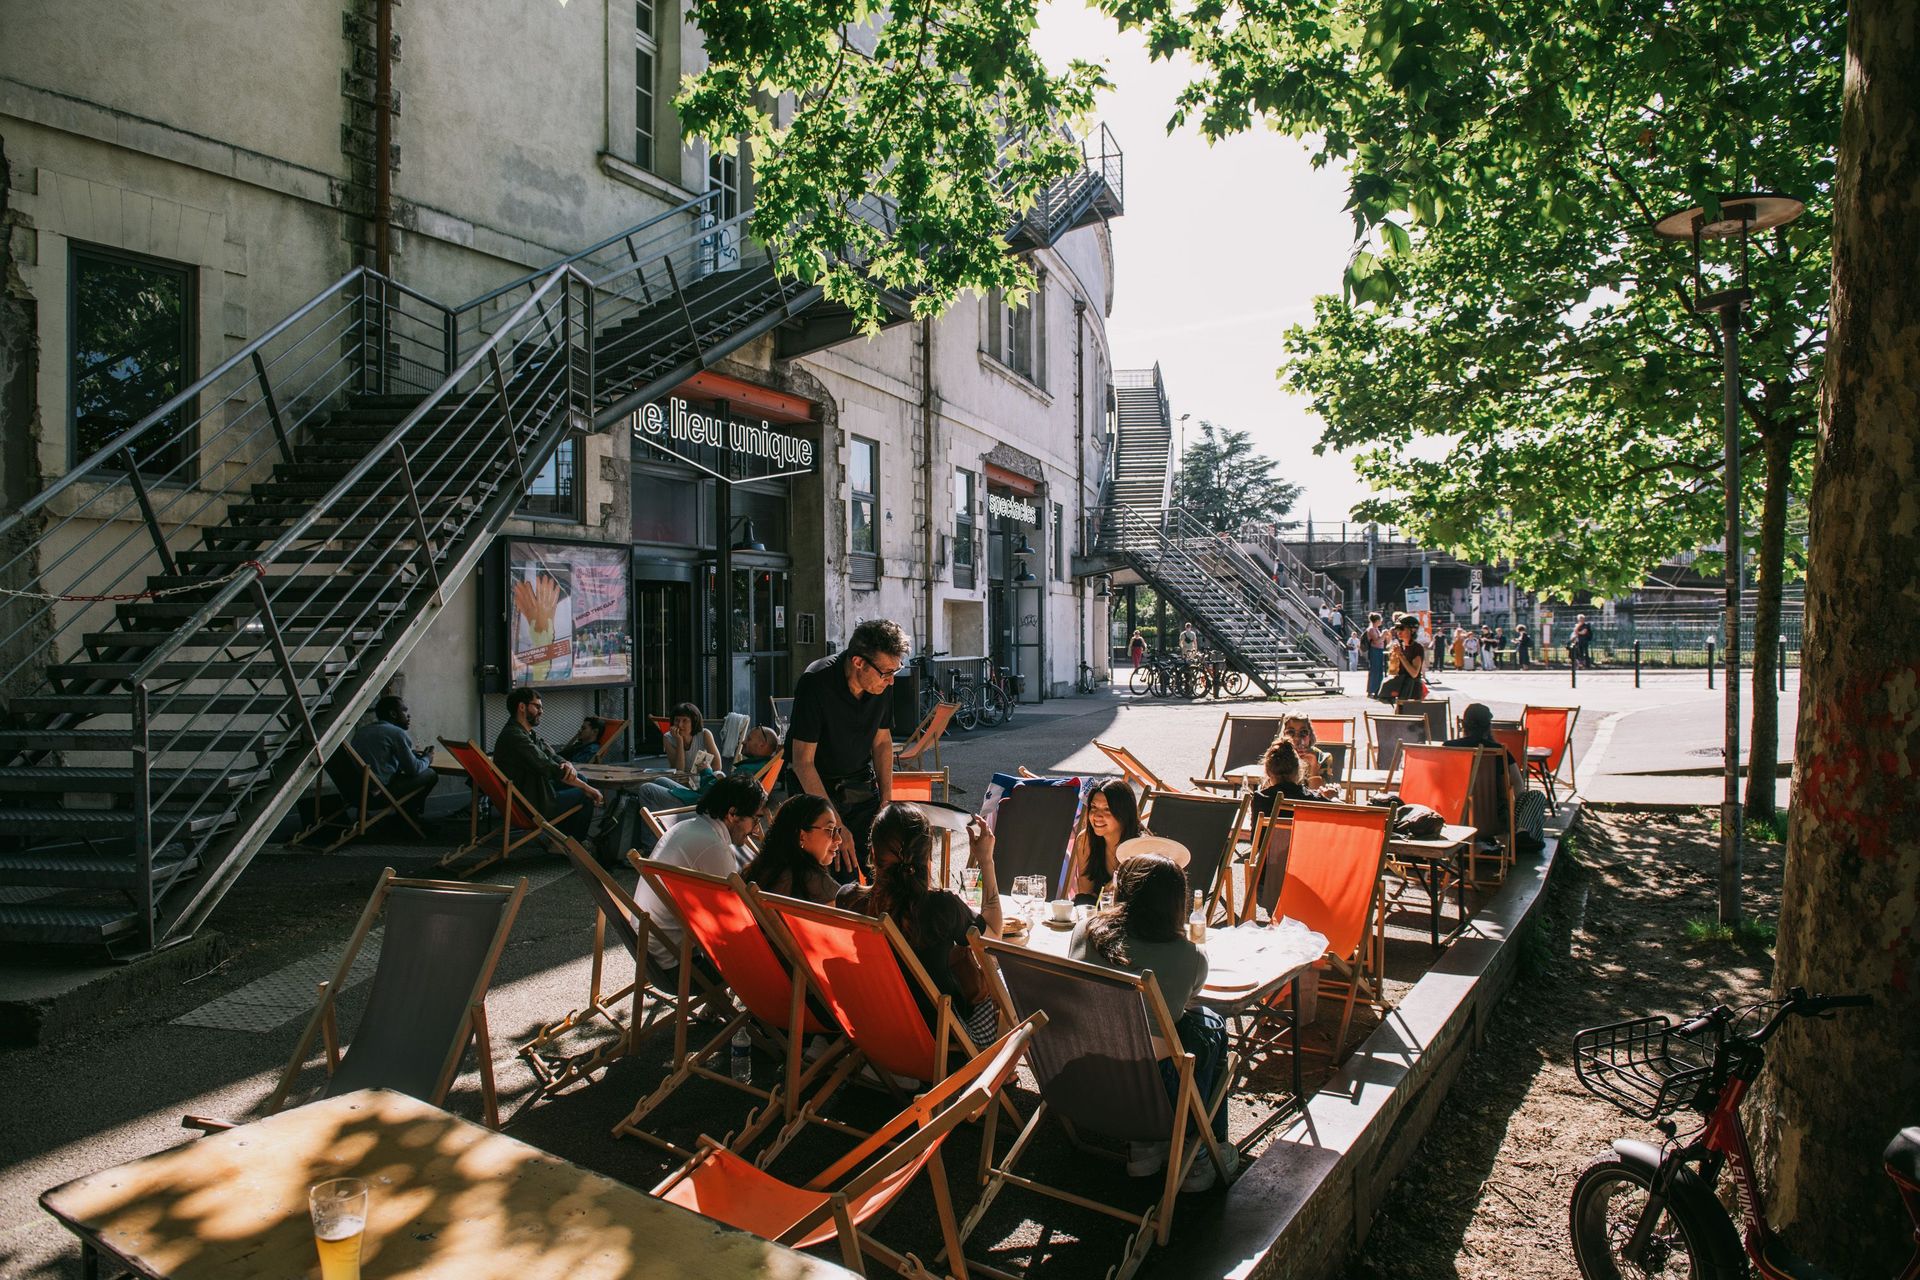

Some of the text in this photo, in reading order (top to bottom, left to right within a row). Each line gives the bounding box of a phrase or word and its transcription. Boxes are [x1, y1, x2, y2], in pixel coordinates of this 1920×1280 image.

[670, 397, 722, 447] lieu
[729, 420, 813, 468] unique
[989, 494, 1036, 524] spectacles
[1472, 583, 1481, 593] Z
[1732, 1165, 1757, 1226] ELWING
